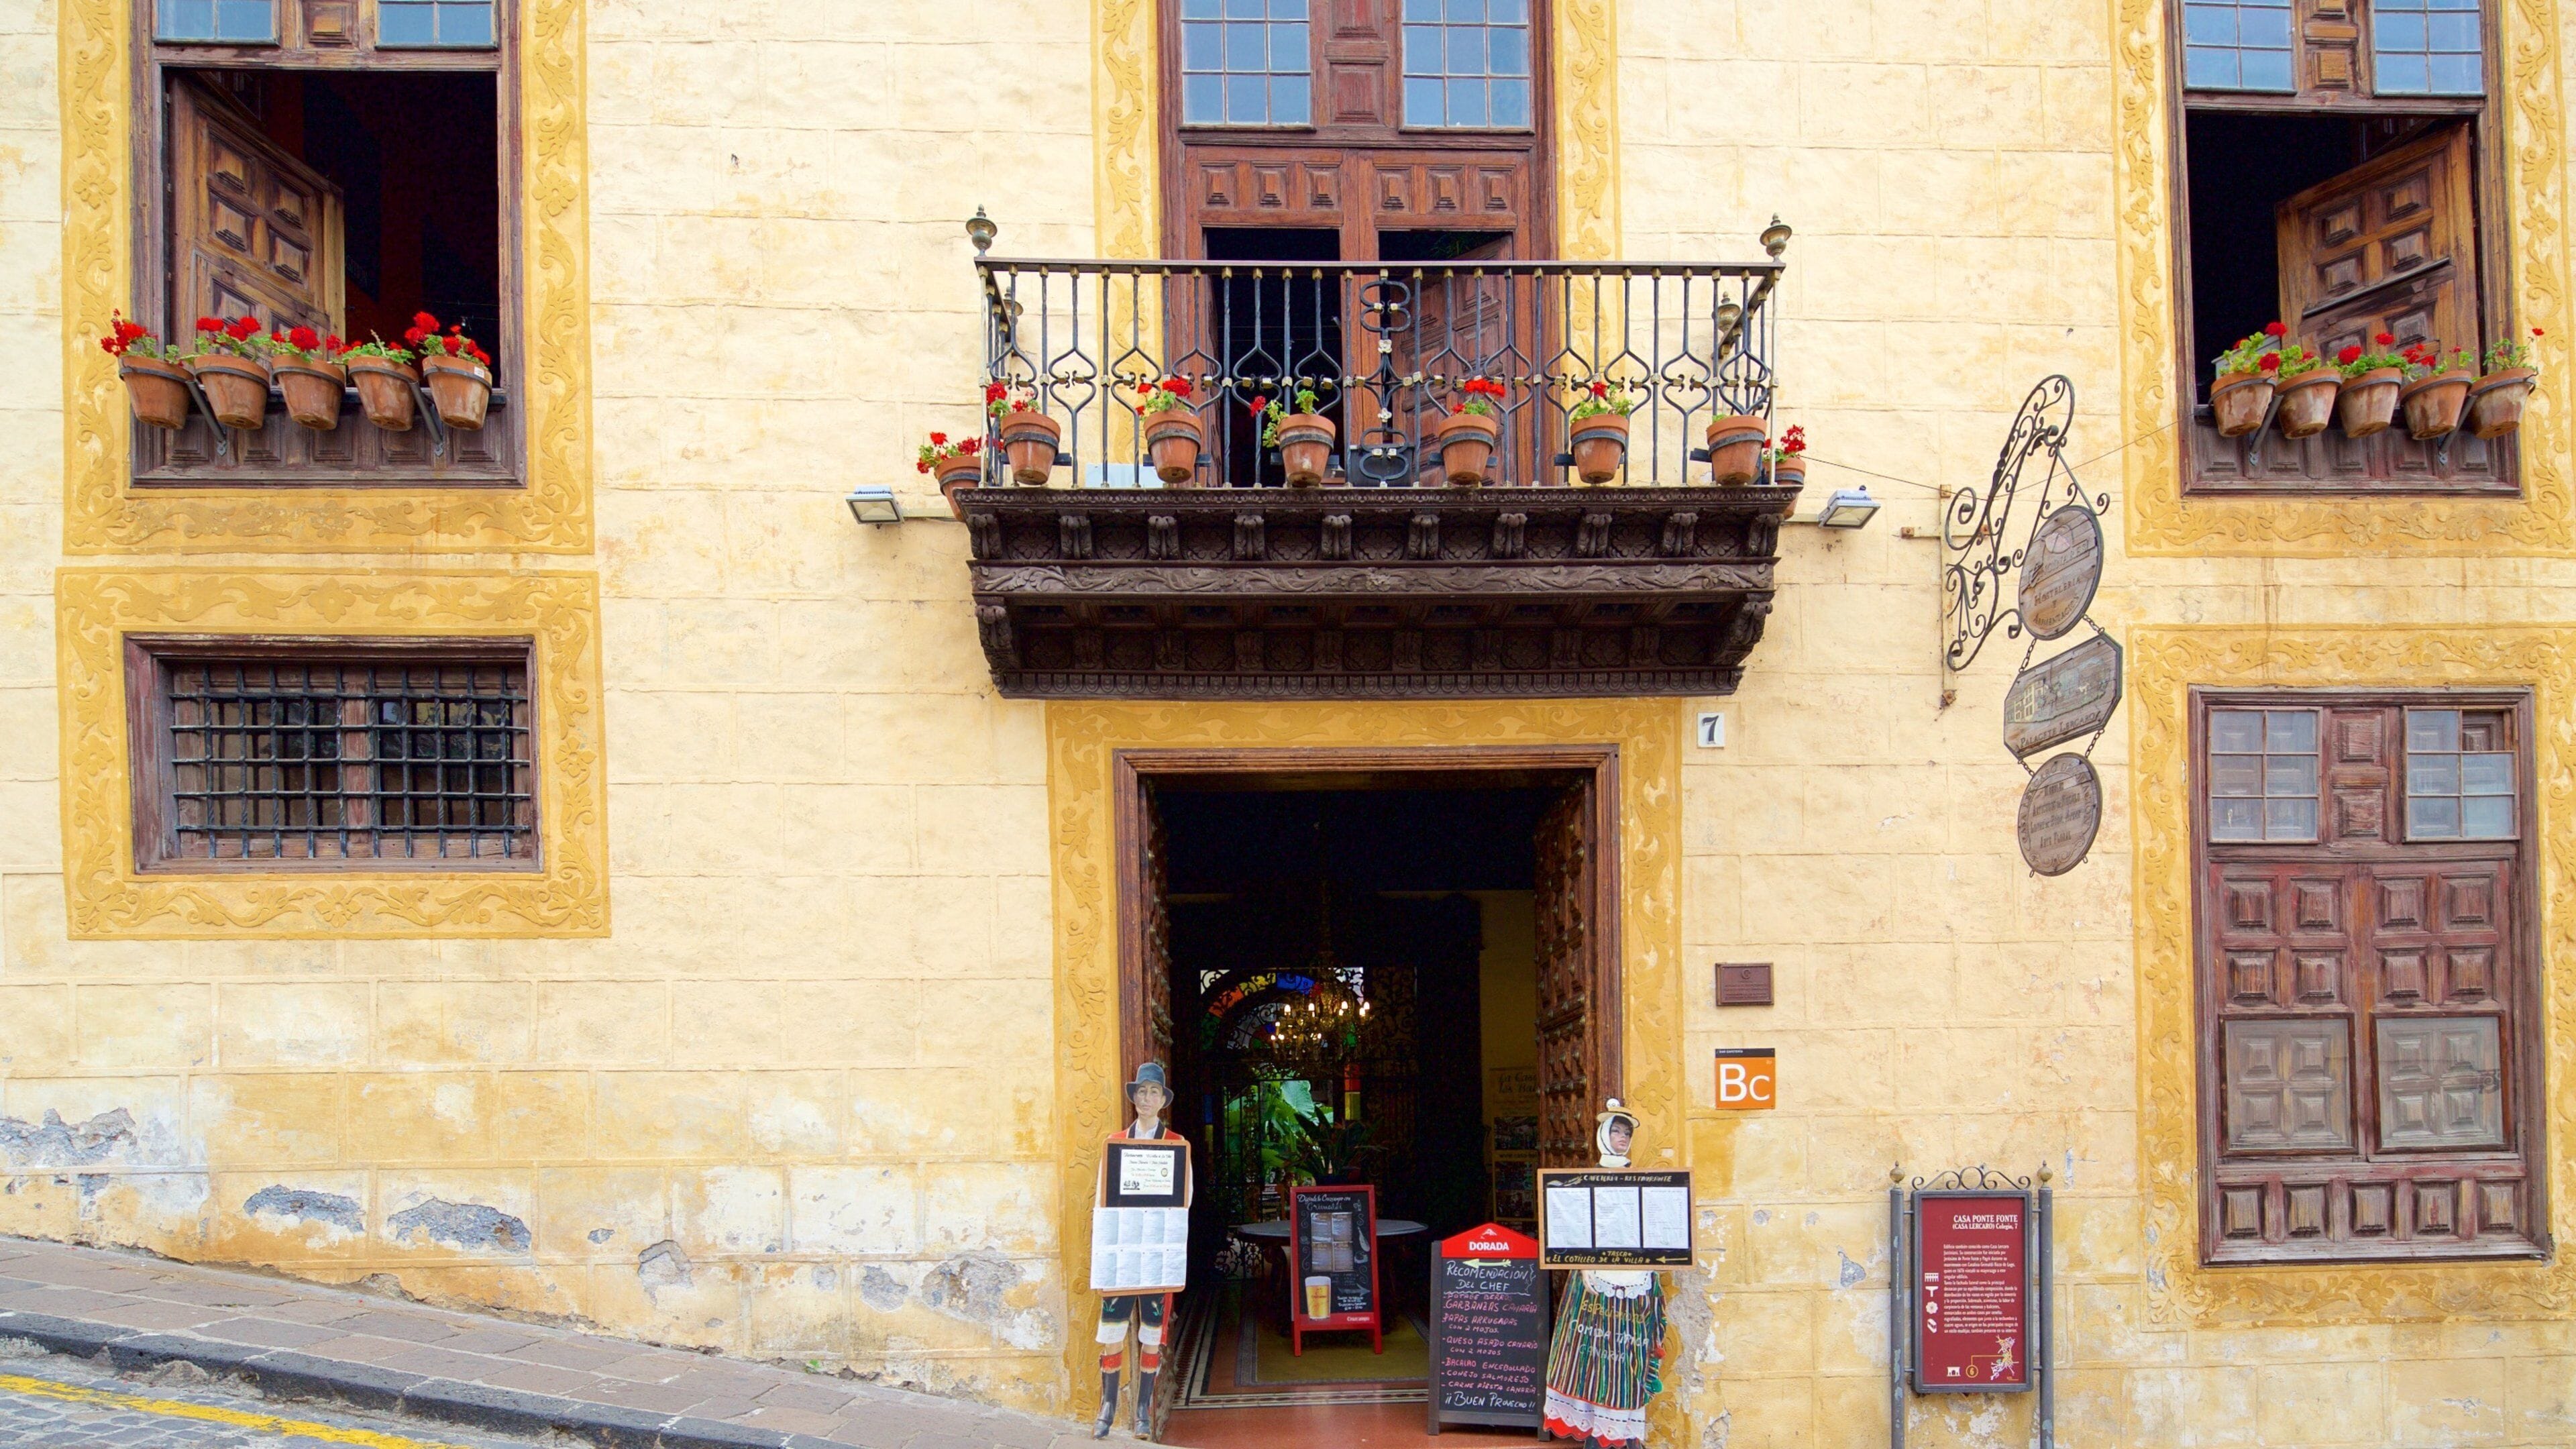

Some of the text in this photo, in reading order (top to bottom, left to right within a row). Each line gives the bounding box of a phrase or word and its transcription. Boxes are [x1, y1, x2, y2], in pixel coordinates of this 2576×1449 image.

[1701, 715, 1719, 744] 7
[2020, 712, 2096, 748] PALACETE LERCARO
[1469, 1242, 1509, 1250] DORADA
[1552, 1254, 1561, 1263] EL
[1456, 1279, 1509, 1291] DEL CHEF
[1472, 1316, 1517, 1326] ARRUGADAS
[1570, 1320, 1611, 1342] COMIDA
[1477, 1337, 1505, 1348] ASADO
[1482, 1362, 1536, 1374] ENCEBOLLADO
[1446, 1369, 1529, 1384] CONEJO SALMOREJO
[1448, 1381, 1474, 1389] CARNE
